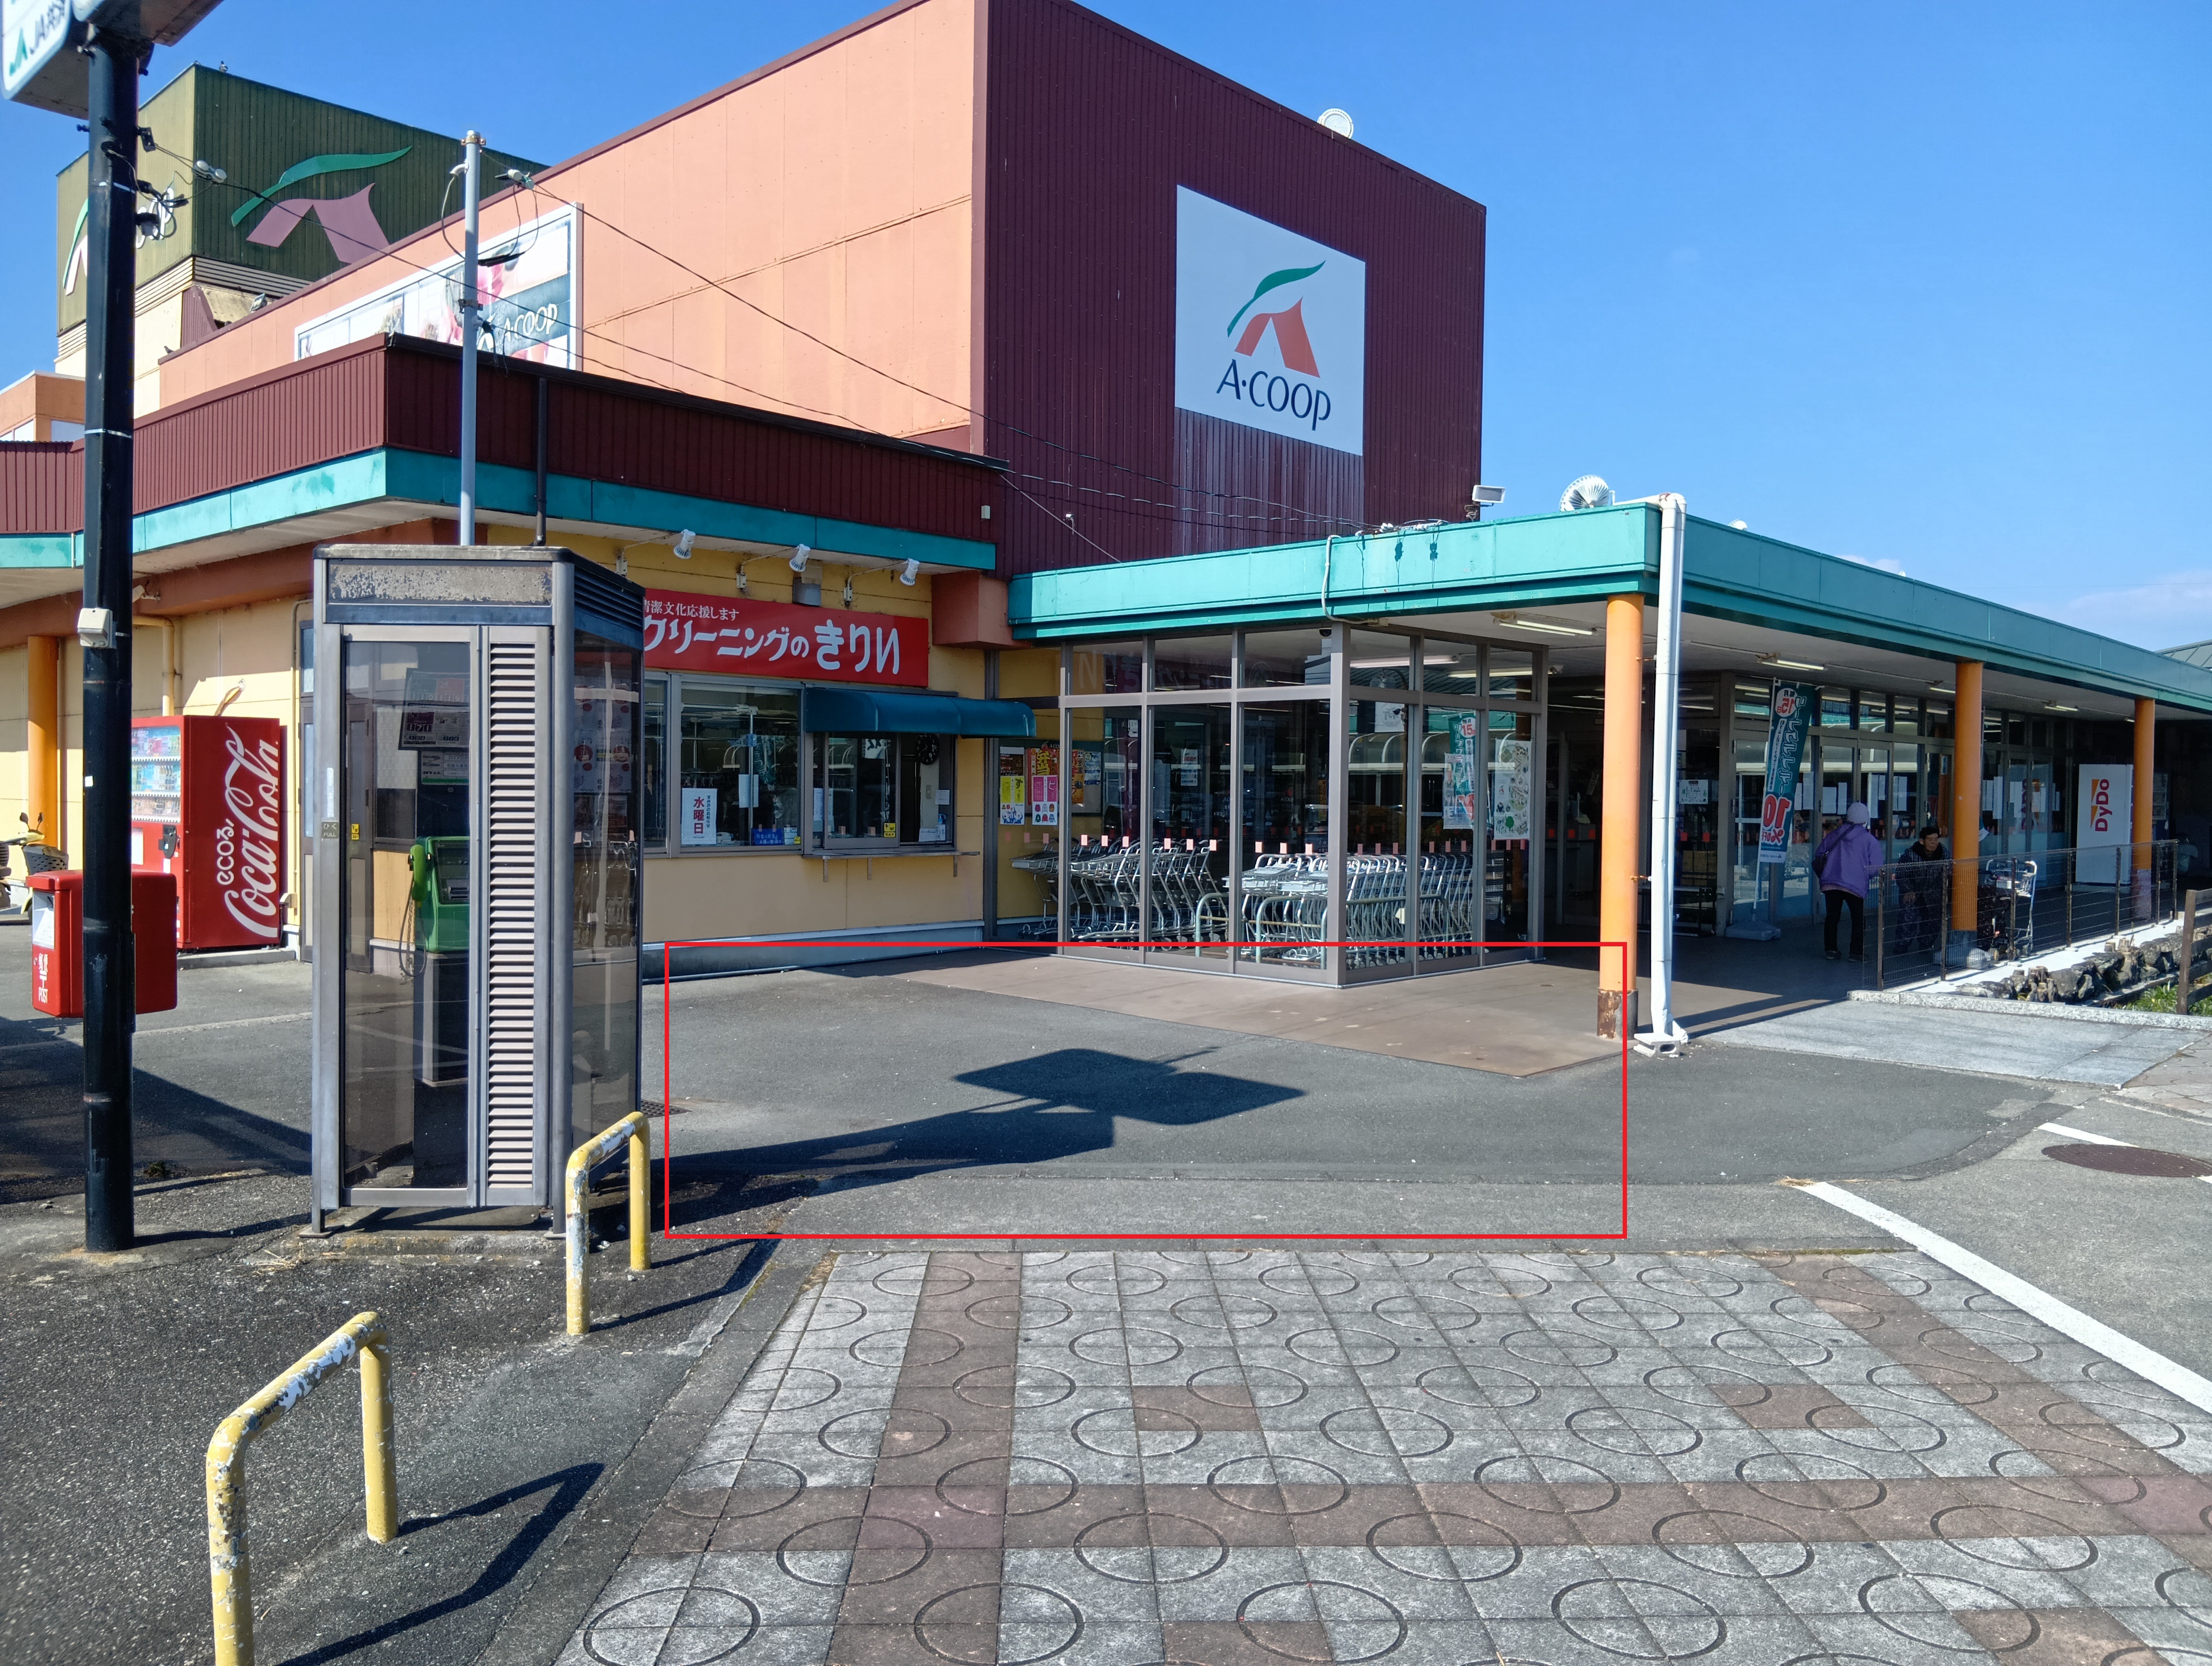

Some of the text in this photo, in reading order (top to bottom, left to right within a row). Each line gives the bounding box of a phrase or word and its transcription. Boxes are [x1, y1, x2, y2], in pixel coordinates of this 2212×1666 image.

[693, 796, 705, 834] 水曜日
[2095, 779, 2112, 831] DyDo
[224, 722, 279, 938] Coca-Cola
[38, 953, 48, 972] 郵便
[38, 986, 48, 1004] POST
